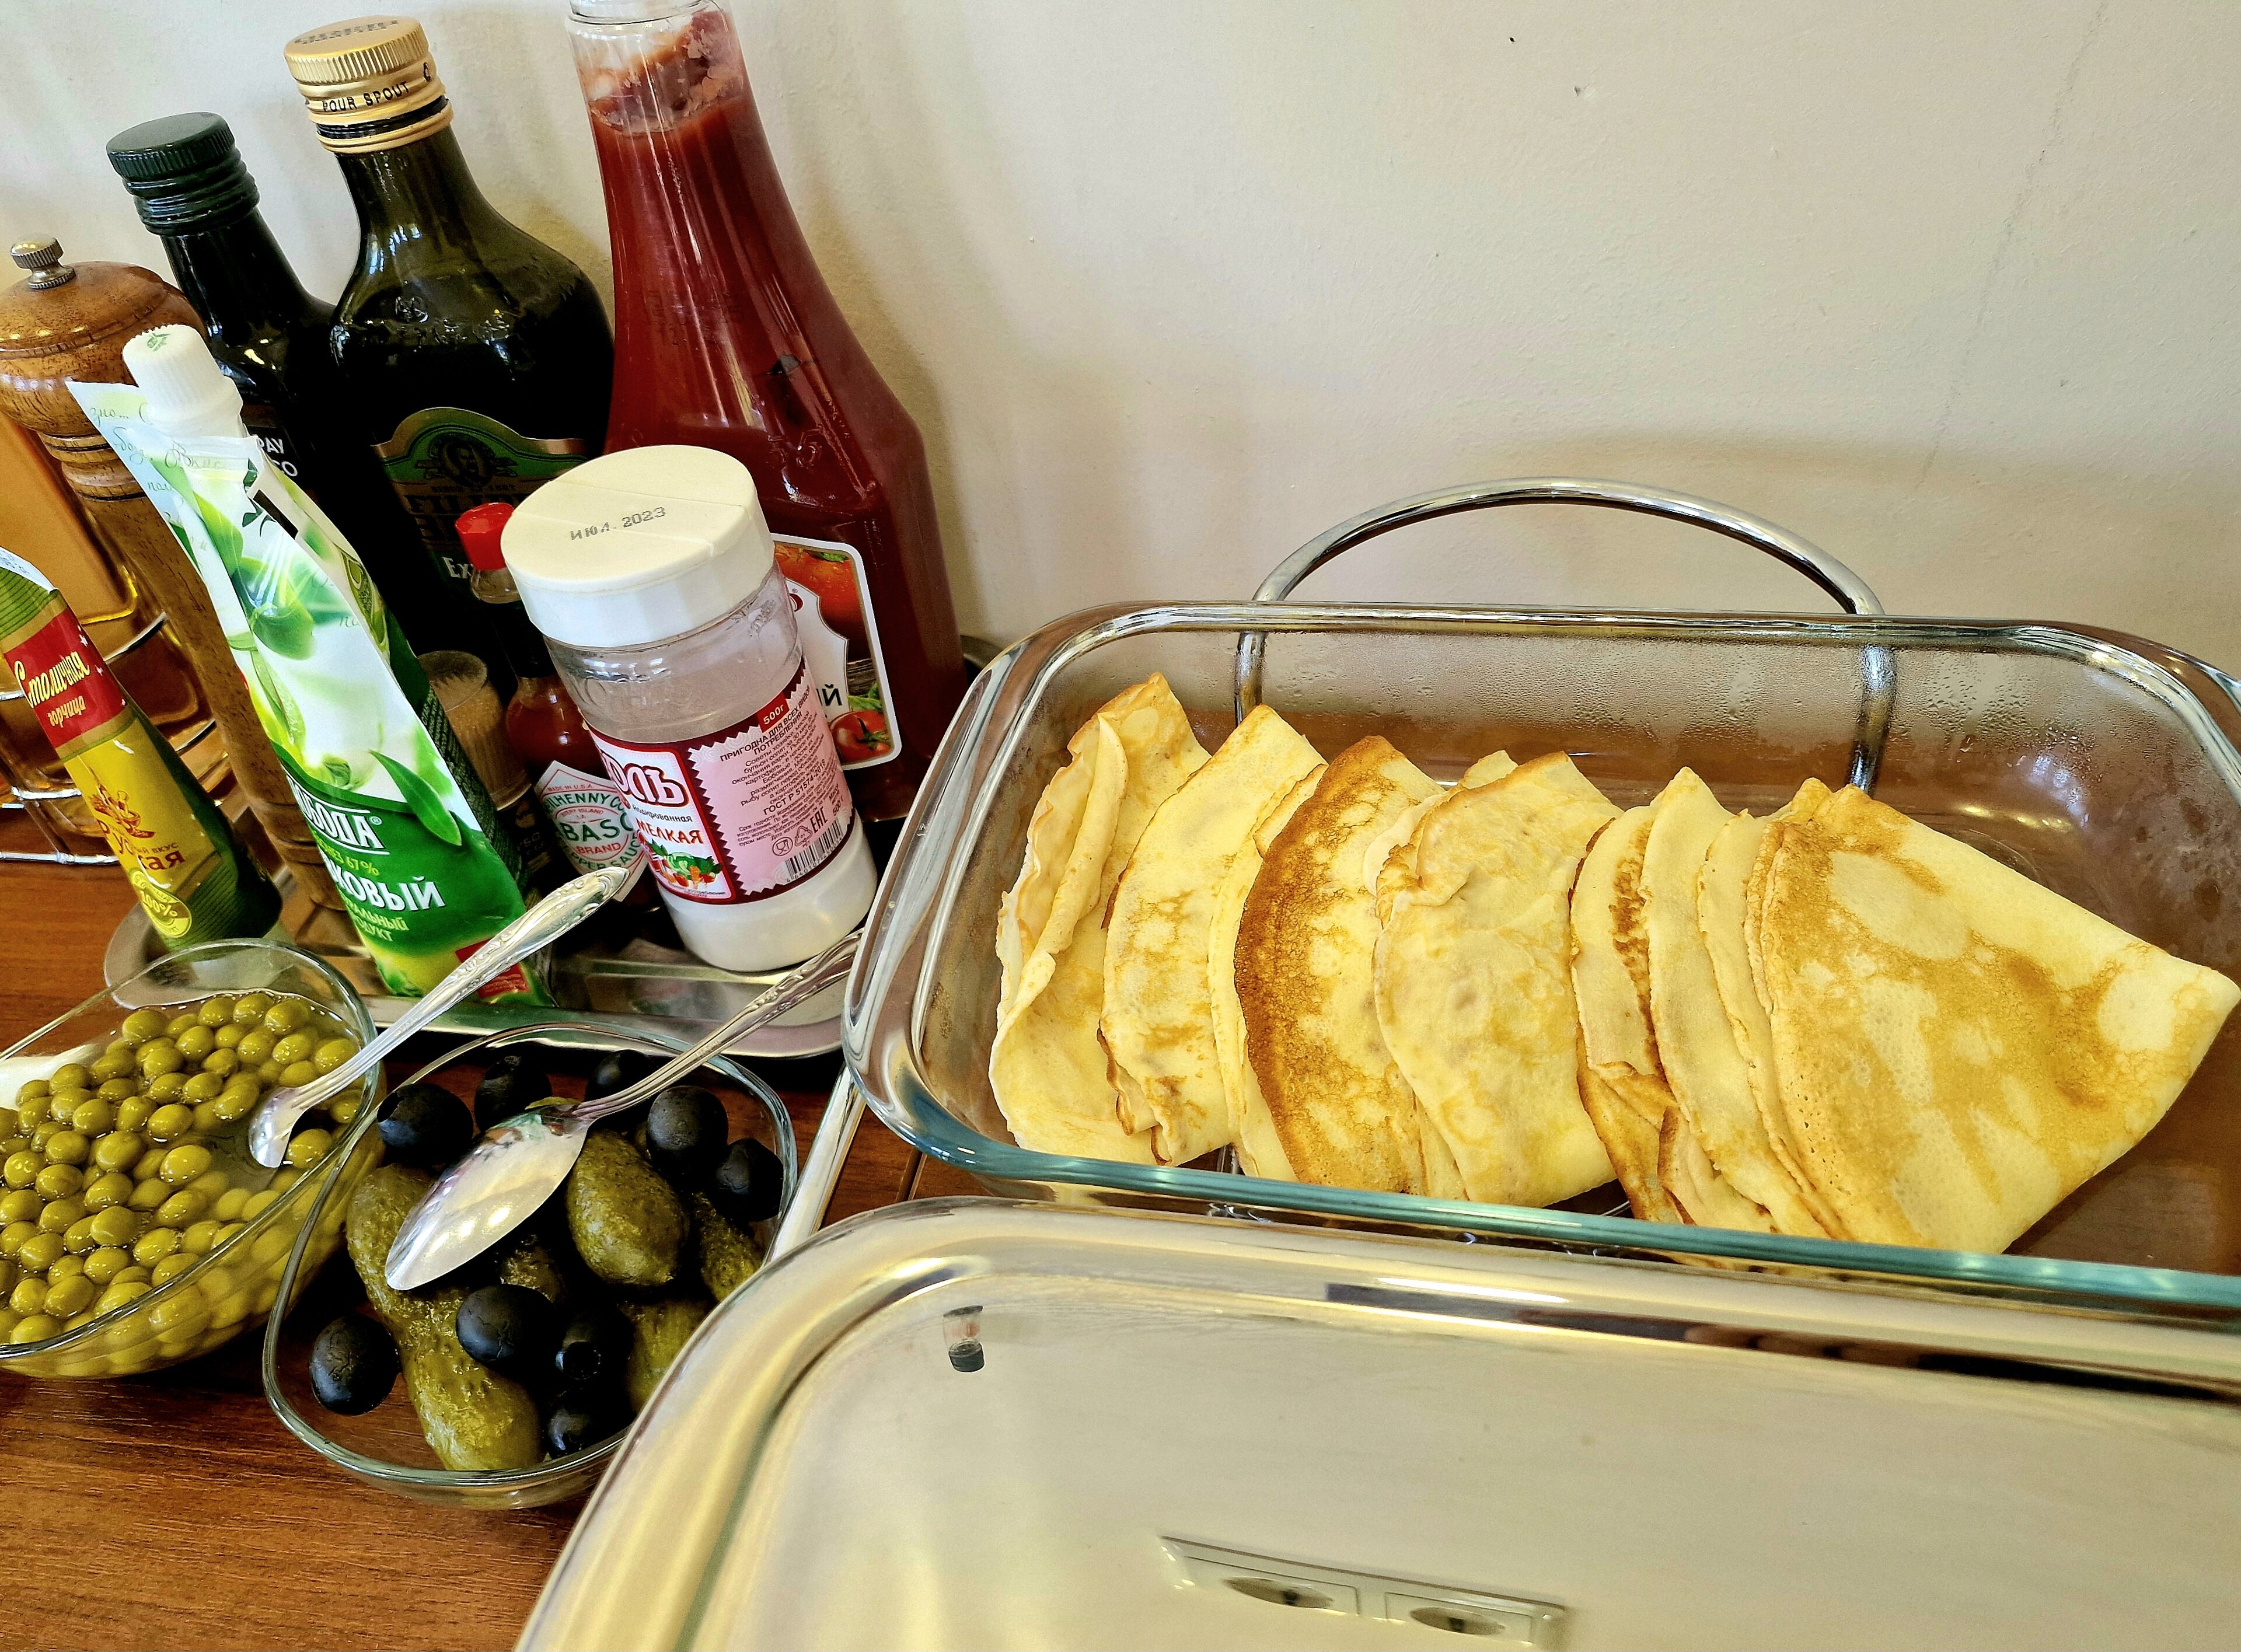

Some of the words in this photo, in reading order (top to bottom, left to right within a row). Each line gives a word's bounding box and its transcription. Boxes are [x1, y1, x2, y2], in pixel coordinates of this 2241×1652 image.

[322, 96, 357, 113] POUR
[363, 81, 410, 107] SPOUT
[622, 507, 666, 528] 2023
[442, 556, 473, 579] Ex
[15, 651, 90, 708] Столичная
[816, 683, 843, 707] Й
[47, 695, 86, 728] горчица
[763, 704, 785, 725] 500г
[720, 735, 769, 762] ПРИГОДНА
[769, 722, 783, 739] ДЛЯ
[783, 706, 799, 725] ВСЕХ
[753, 711, 802, 755] ПОТРЕБЛЕНИЯ
[743, 759, 769, 774] бульон
[769, 746, 786, 760] солят
[793, 732, 800, 741] 30
[745, 750, 772, 767] Советы
[732, 764, 770, 784] окончания
[745, 764, 781, 786] картофель
[762, 763, 791, 784] Бобовые
[741, 795, 760, 806] рыбу
[761, 784, 780, 797] солят
[763, 797, 787, 815] ГОСТ
[788, 792, 794, 801] Р
[832, 800, 842, 816] 500
[634, 817, 704, 844] МЕЛКАЯ
[739, 824, 752, 832] Срок
[575, 842, 621, 855] BRAND
[345, 855, 380, 876] 67%
[139, 889, 178, 917] 100%
